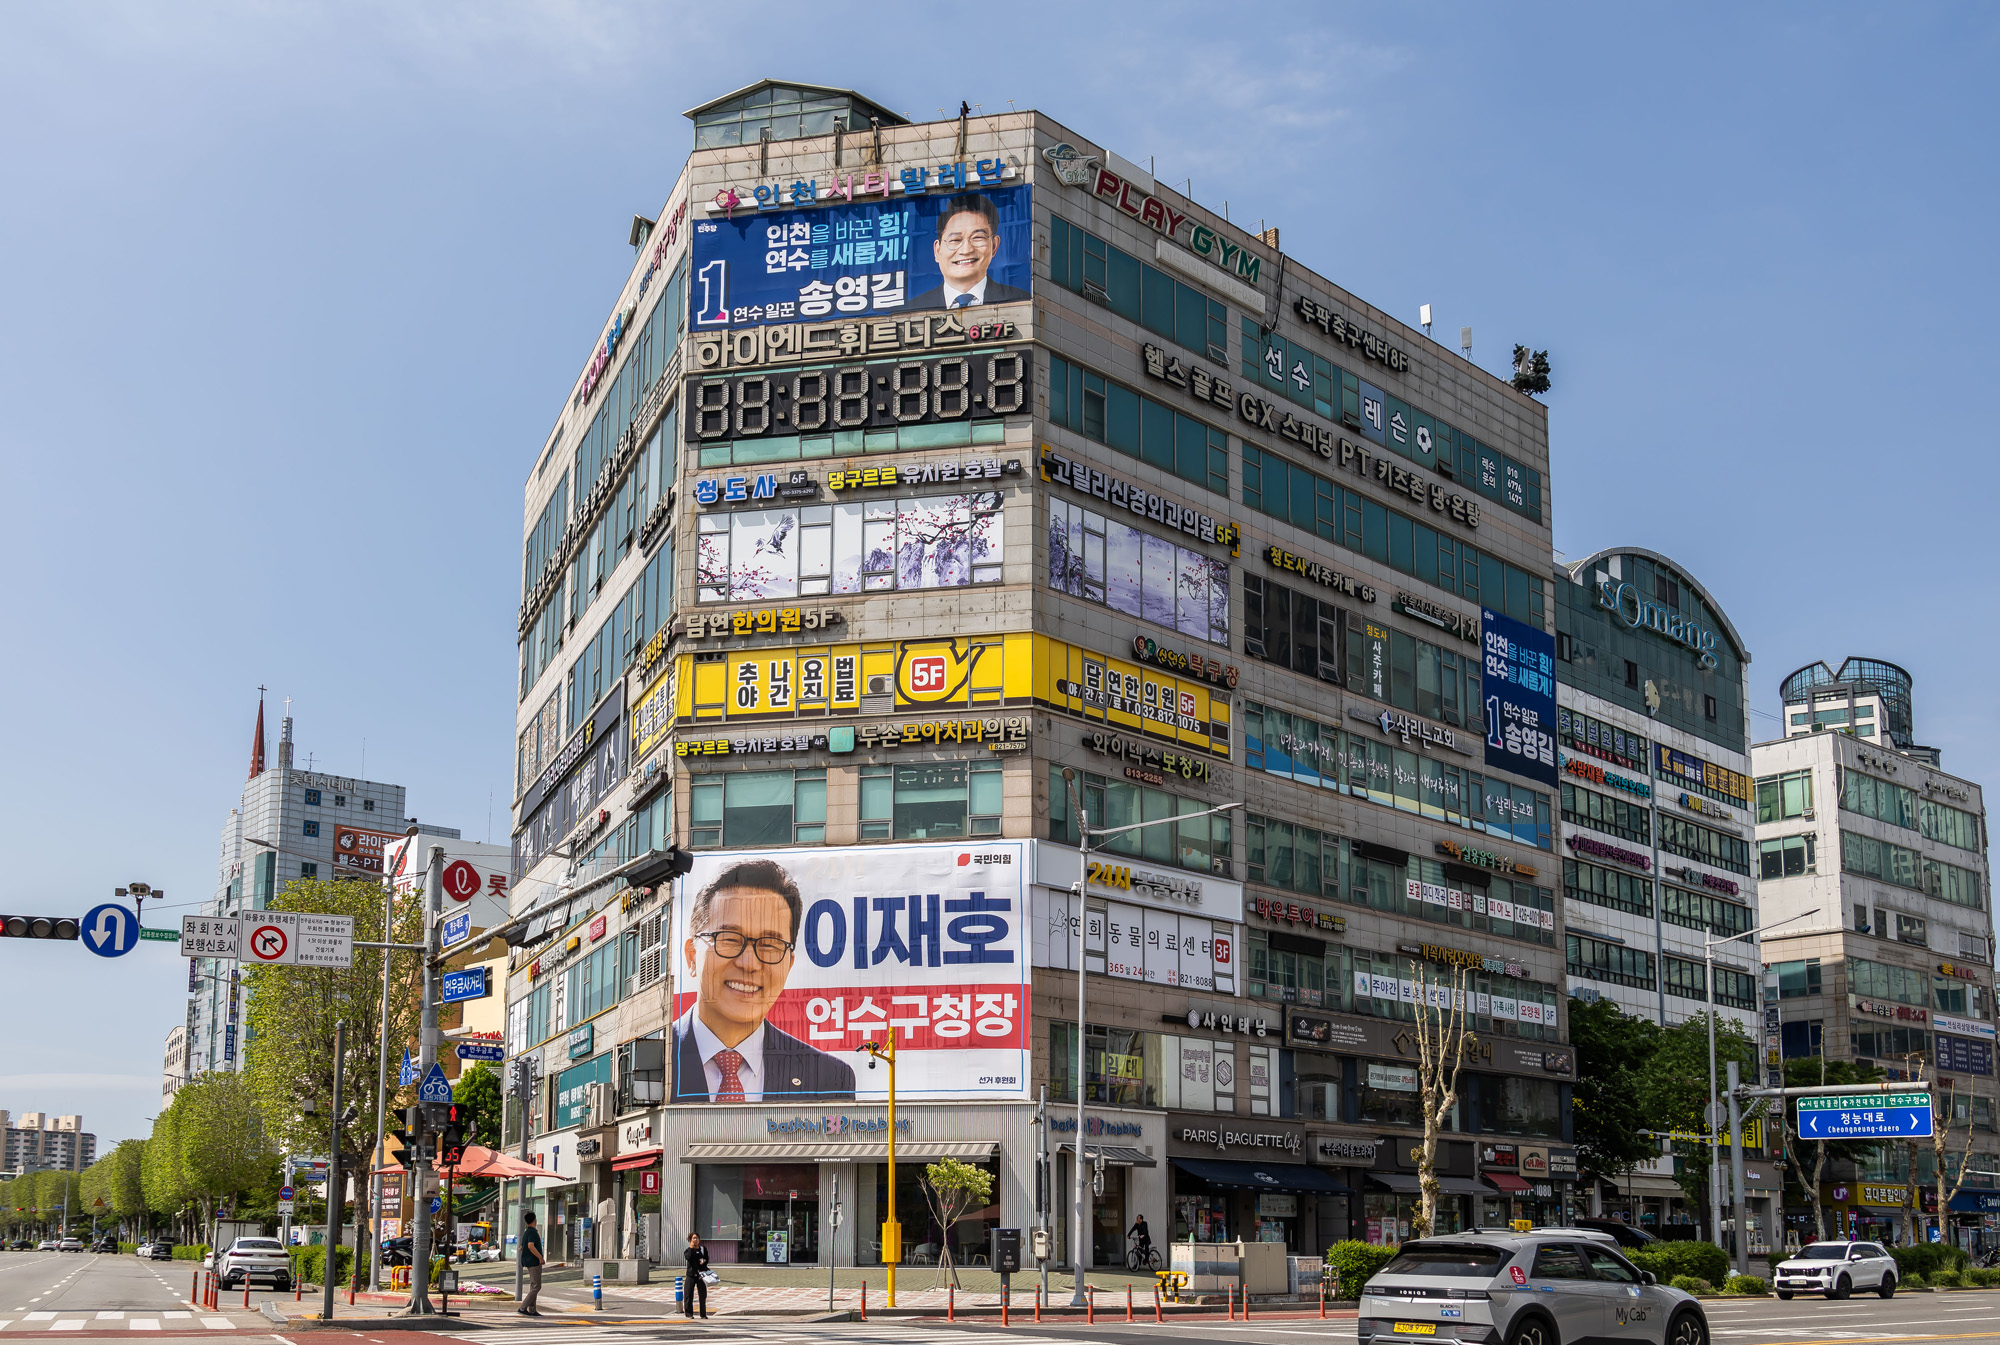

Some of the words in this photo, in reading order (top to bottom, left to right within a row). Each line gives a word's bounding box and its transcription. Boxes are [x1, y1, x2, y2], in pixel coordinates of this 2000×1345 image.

[766, 221, 830, 249] 인천을
[835, 218, 873, 242] 바꾼
[878, 211, 909, 238] 힘!
[1093, 168, 1187, 239] PLAY
[1190, 224, 1261, 286] GYM
[765, 247, 829, 274] 연수를
[831, 235, 909, 267] 새롭게!
[697, 260, 729, 326] 1
[733, 304, 763, 323] 연수
[765, 301, 795, 319] 일꾼
[799, 270, 905, 316] 송영길
[696, 315, 965, 368] 하이엔드휘트니스
[1264, 346, 1311, 392] 선수
[1364, 397, 1408, 445] 레슨
[1145, 343, 1187, 388] 헬스
[1192, 366, 1233, 411] 골프
[1240, 393, 1275, 433] GX
[1282, 412, 1333, 459] 스피닝
[1340, 437, 1370, 476] PT
[1377, 458, 1425, 503] 키즈존
[828, 466, 898, 490] 댕구르르
[902, 460, 960, 484] 유치원
[963, 458, 1002, 480] 호텔
[1007, 460, 1020, 471] 4F
[1481, 456, 1496, 475] 레슨
[1481, 471, 1496, 489] 문의
[1506, 465, 1519, 480] 010
[696, 473, 778, 504] 청도사
[791, 473, 806, 485] 6F
[1052, 452, 1216, 544] 고릴라신경외과의원
[1215, 524, 1233, 546] 5F
[1507, 477, 1523, 494] 6776
[1270, 546, 1307, 578] 청도사
[1309, 562, 1355, 598] 사주카페
[1361, 584, 1376, 603] 6F
[686, 607, 801, 639] 담연한의원
[804, 605, 835, 629] 5F
[1366, 623, 1388, 643] 청도사
[1485, 631, 1517, 662] 인천을
[1519, 646, 1538, 669] 바꾼
[1538, 652, 1553, 677] 힘!
[736, 656, 856, 686] 추나요법
[913, 663, 946, 689] 5F
[1372, 641, 1383, 699] 사주카페
[1486, 654, 1517, 684] 연수를
[1518, 665, 1553, 699] 새롭게!
[1086, 662, 1176, 714] 담연한의원
[1180, 696, 1196, 714] 5F
[1486, 694, 1504, 750] 1
[1503, 700, 1521, 722] 연수
[1521, 707, 1539, 728] 일꾼
[675, 739, 729, 756] 댕구르르
[734, 737, 778, 754] 유치원
[780, 735, 809, 752] 호텔
[859, 717, 1027, 748] 두손모아치과의원
[1396, 714, 1455, 750] 살리는교회
[1505, 721, 1555, 768] 송영길
[1561, 713, 1638, 757] 주간보호센터
[1093, 731, 1208, 784] 와이덱스보청기
[1125, 766, 1163, 785] 813-2255
[973, 853, 1012, 866] 국민의힘
[1087, 862, 1131, 891] 24시
[244, 914, 265, 923] 화물차
[268, 914, 296, 924] 통행제한
[1256, 897, 1316, 929] 대우투어
[186, 920, 237, 937] 좌회전시
[804, 892, 1015, 970] 이재호
[185, 938, 237, 955] 보행신호시
[1216, 942, 1229, 960] 3F
[445, 973, 482, 997] 먼우금사거리
[1372, 979, 1397, 995] 주야간
[805, 993, 1018, 1041] 연수구청장
[1520, 1004, 1541, 1020] 요양원
[1545, 1009, 1555, 1022] 3F
[978, 1076, 993, 1085] 선거
[994, 1075, 1017, 1085] 후원회
[1889, 1096, 1919, 1106] 연수구청
[767, 1116, 820, 1134] baskin
[822, 1114, 849, 1135] BR
[1106, 1122, 1143, 1137] robbins
[1828, 1125, 1900, 1135] Cheongneung-daero
[1840, 1111, 1885, 1125] 청능대로
[1183, 1128, 1217, 1144] PARIS
[1226, 1131, 1283, 1146] BAGUETTE
